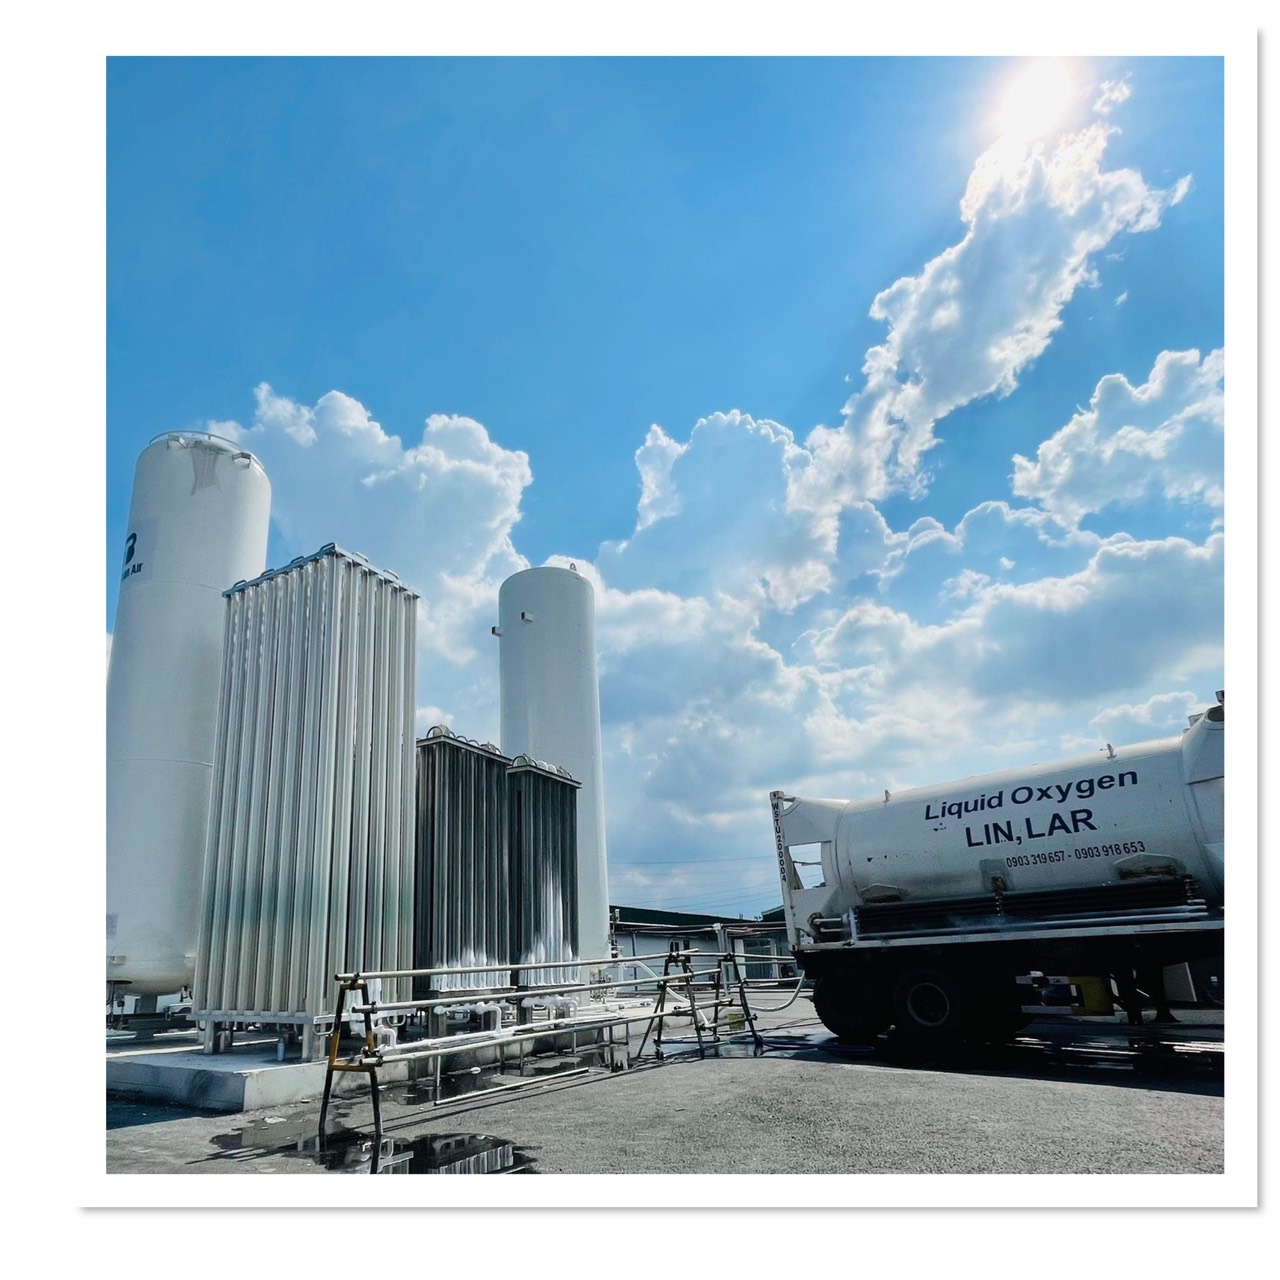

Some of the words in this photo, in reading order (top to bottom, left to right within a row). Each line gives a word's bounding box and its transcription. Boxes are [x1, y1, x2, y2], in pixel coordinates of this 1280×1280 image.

[925, 790, 1004, 820] Liquid
[1011, 770, 1138, 804] Oxygen
[1006, 855, 1030, 868] 0903
[1074, 846, 1101, 860] 0903
[1101, 843, 1122, 857] 918
[1123, 840, 1146, 854] 653
